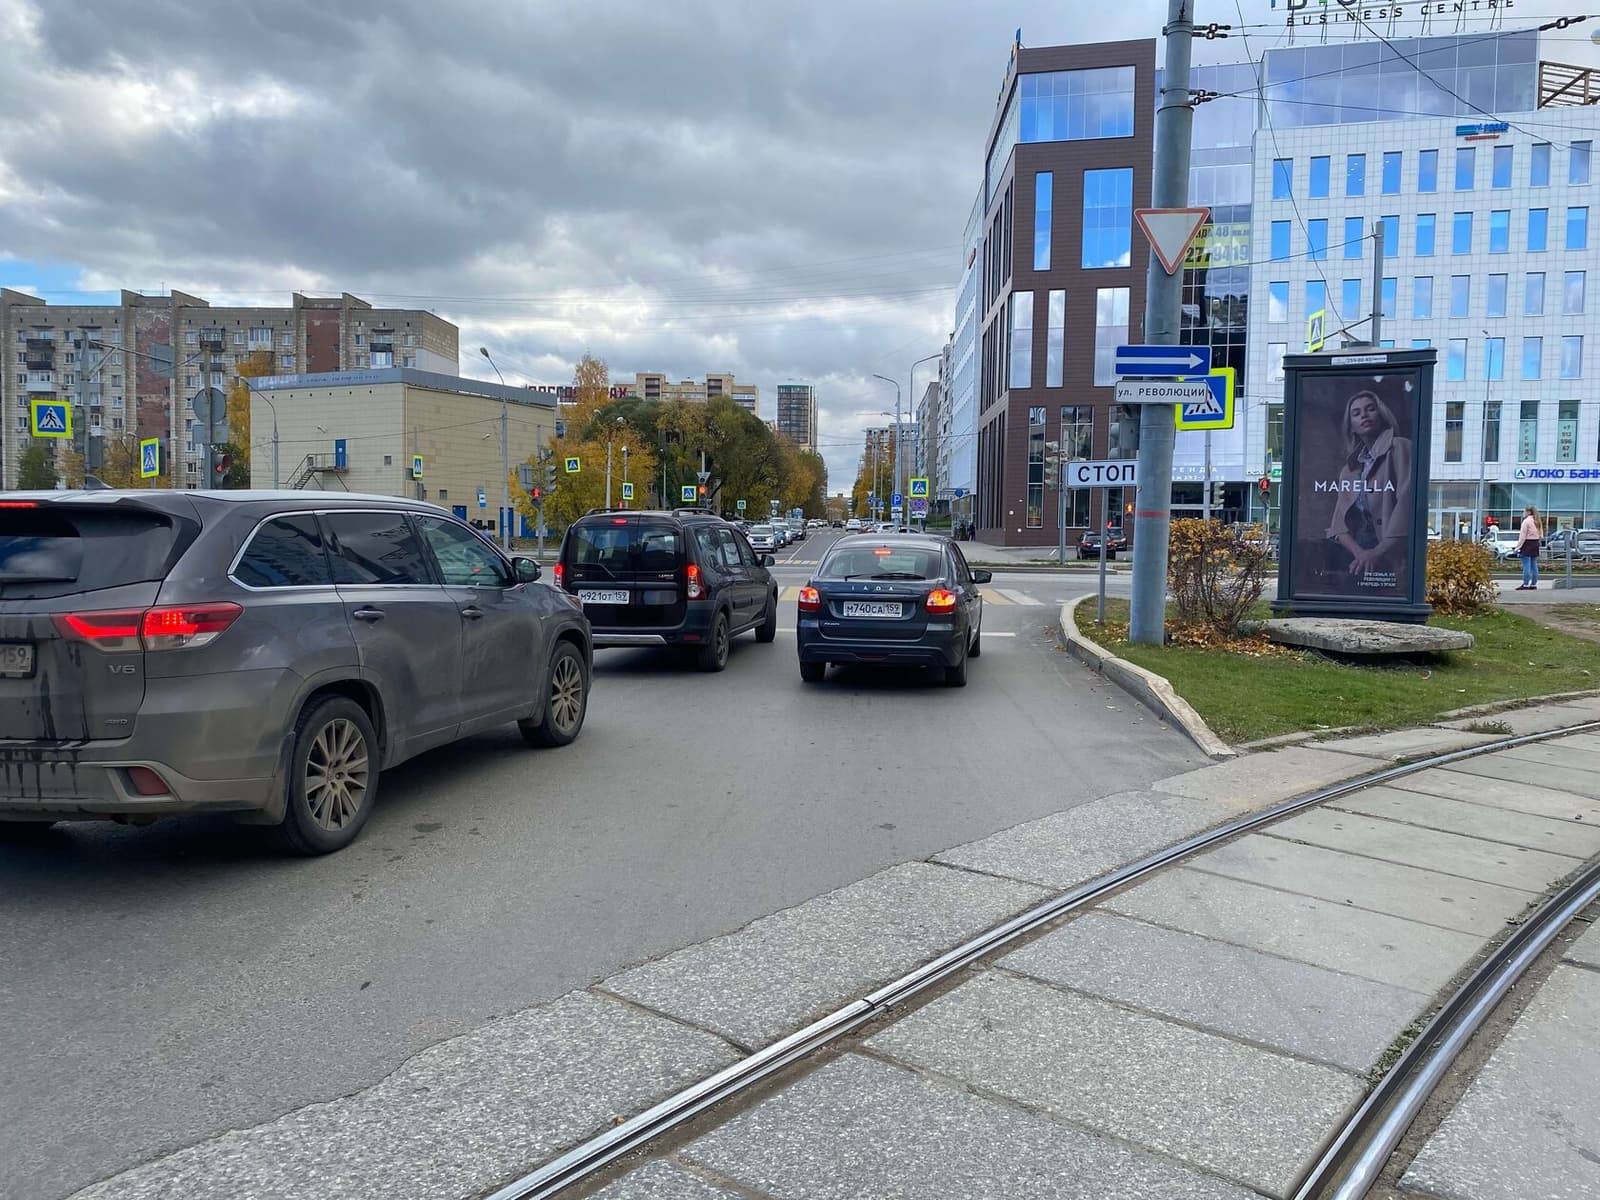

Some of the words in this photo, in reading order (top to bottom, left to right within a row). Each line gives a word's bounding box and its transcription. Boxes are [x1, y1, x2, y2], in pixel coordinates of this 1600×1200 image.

[1287, 7, 1403, 27] BUSINESS
[1420, 0, 1514, 16] CENTRE
[1118, 388, 1132, 397] ул.
[1139, 387, 1205, 397] РЕВОЛЮЦИИ
[1078, 465, 1135, 482] СТОП
[1314, 480, 1395, 492] MARELLA
[108, 664, 136, 673] V6
